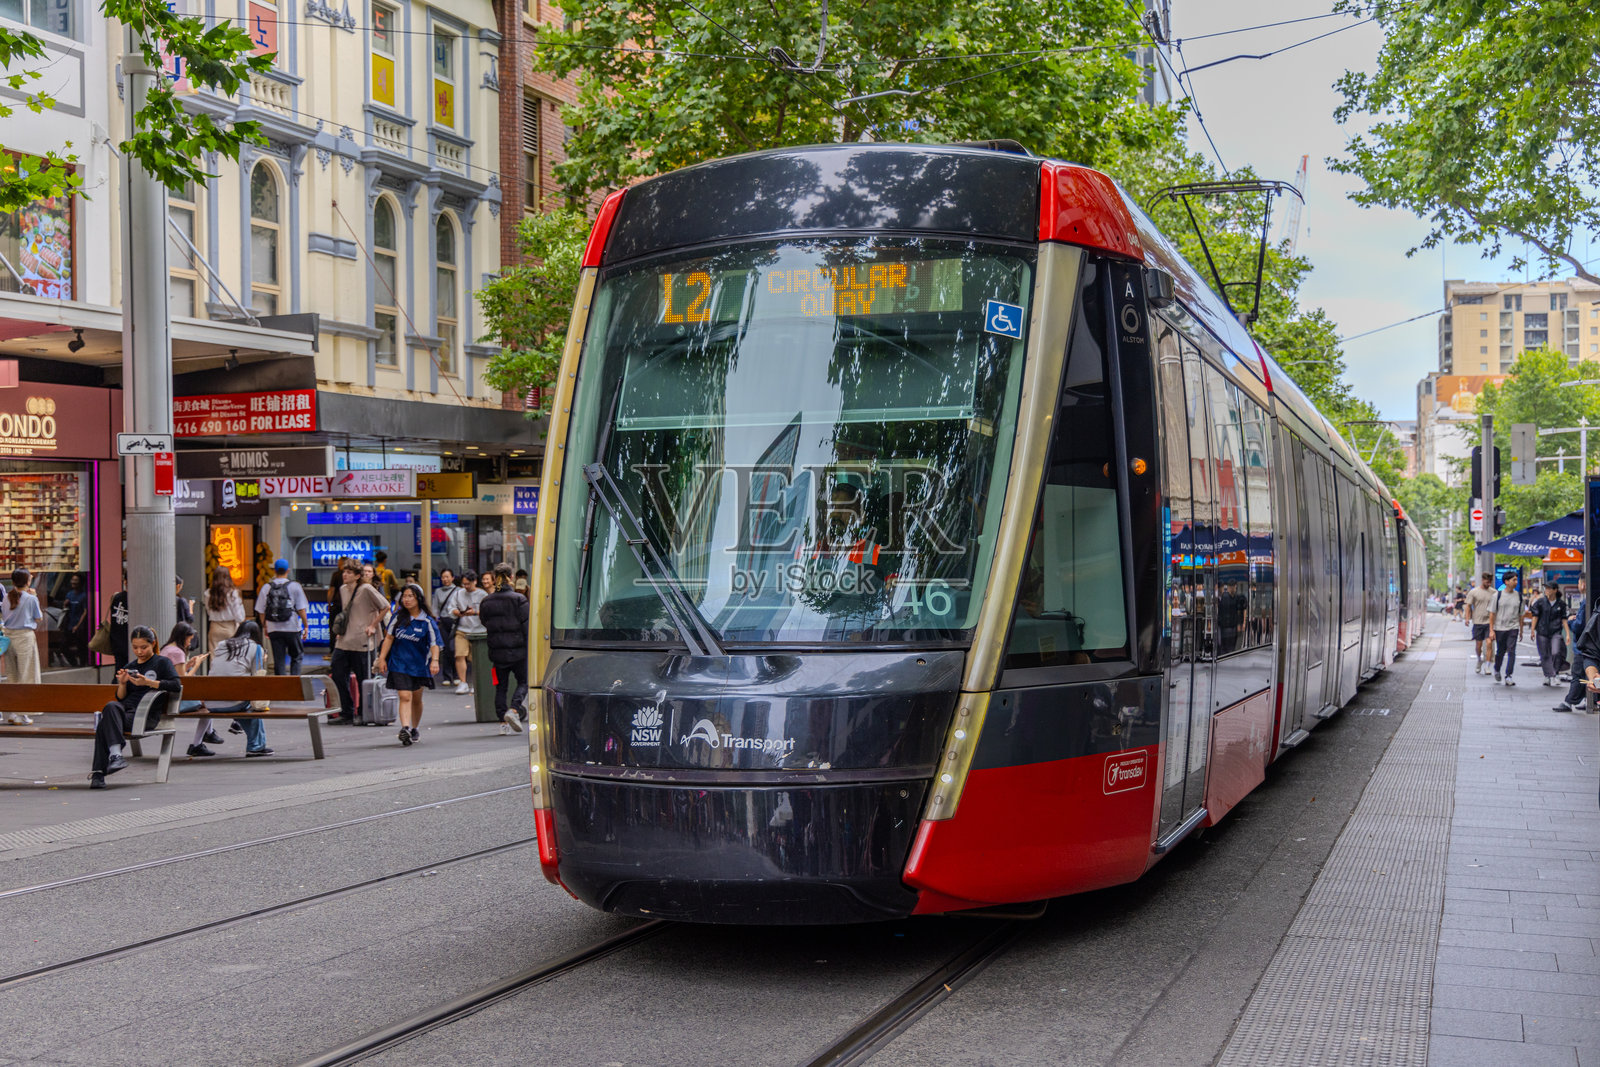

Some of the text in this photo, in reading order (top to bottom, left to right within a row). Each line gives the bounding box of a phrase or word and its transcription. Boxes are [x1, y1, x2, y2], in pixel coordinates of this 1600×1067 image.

[767, 264, 908, 294] CIRCULAR
[663, 271, 711, 323] L2
[1125, 282, 1134, 298] A
[800, 290, 876, 317] QUAY
[1122, 336, 1145, 344] ALSTOM
[200, 420, 222, 433] 490
[226, 419, 247, 432] 160
[250, 414, 311, 431] FOR LEASE
[231, 452, 269, 468] MOMOS
[264, 477, 334, 494] SYDNEY
[343, 482, 406, 494] KARAOKE
[313, 540, 371, 552] CURRENCY
[902, 578, 952, 616] 46
[631, 729, 662, 742] NSW
[721, 733, 796, 752] Transport
[1119, 764, 1144, 781] transdev
